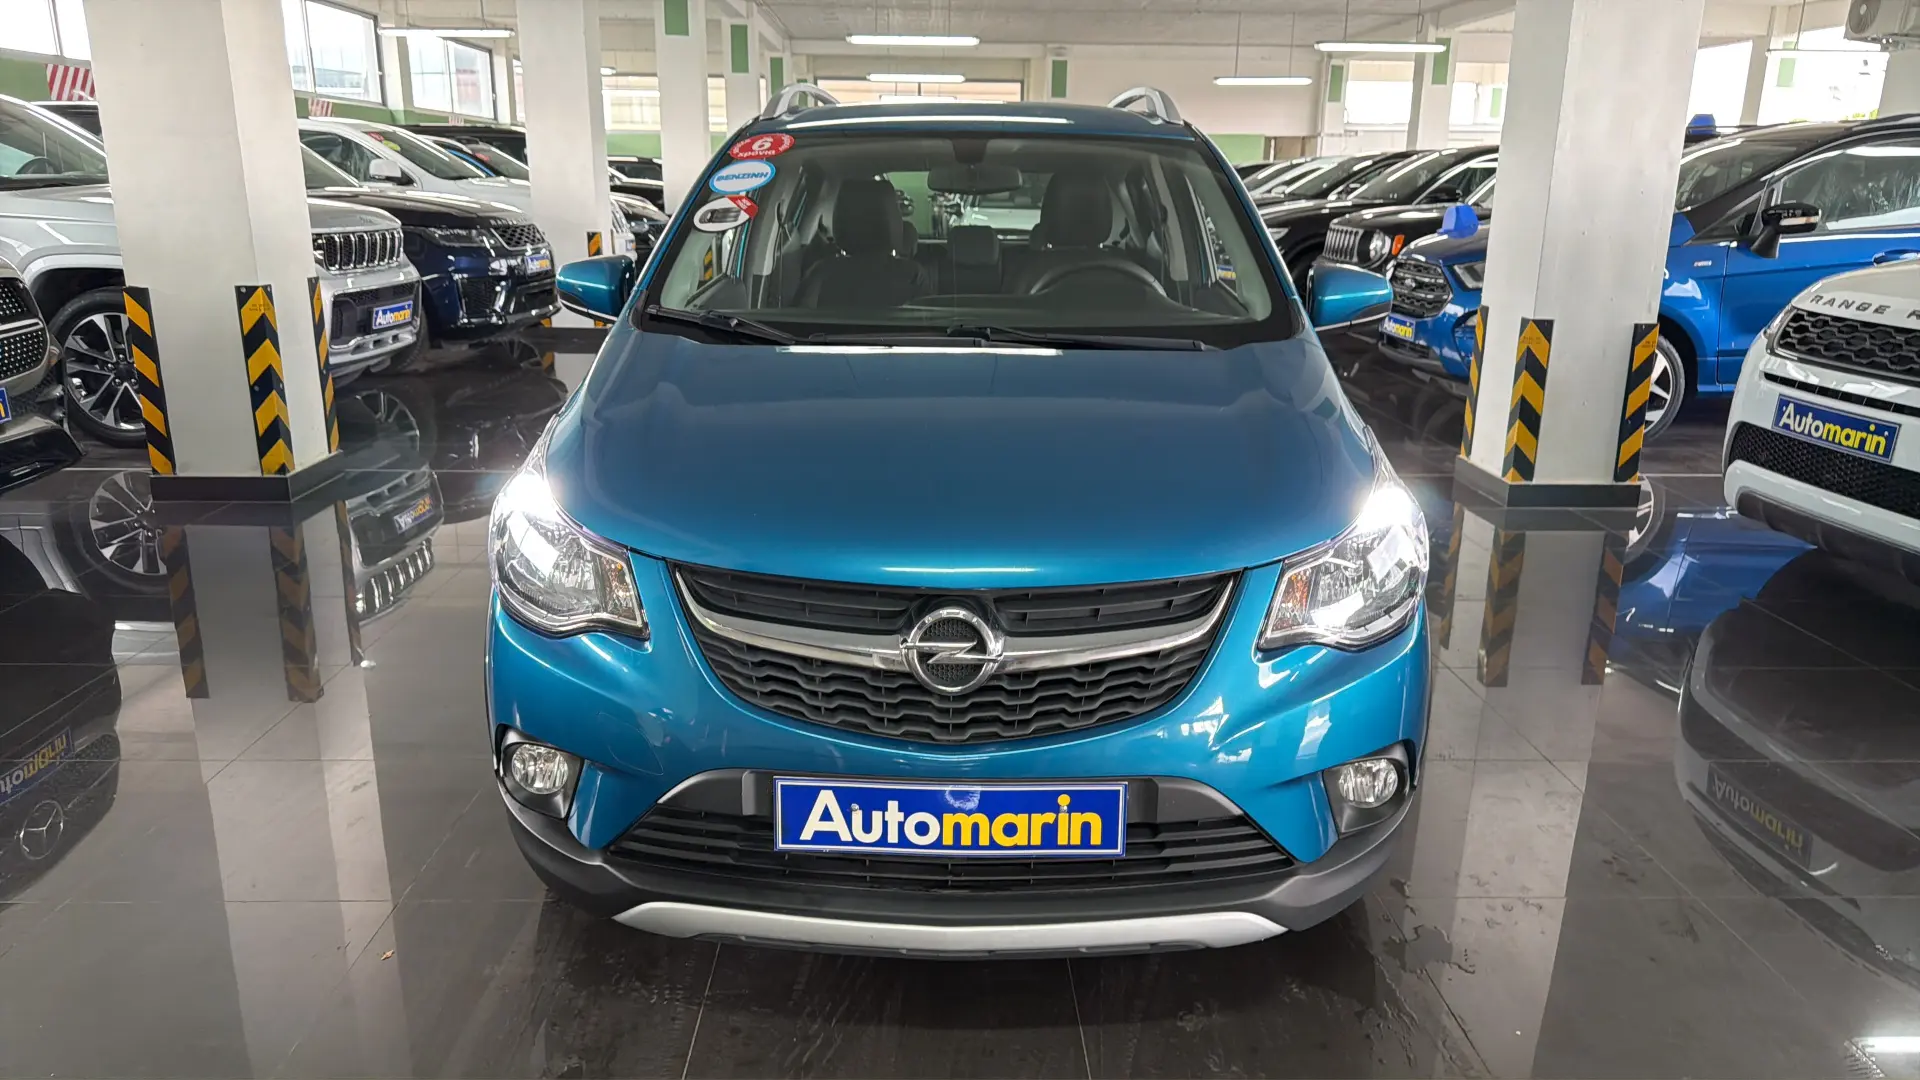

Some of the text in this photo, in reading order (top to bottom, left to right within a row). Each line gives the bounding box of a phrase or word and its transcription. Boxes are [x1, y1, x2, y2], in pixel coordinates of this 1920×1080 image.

[752, 136, 774, 151] 6
[1809, 294, 1891, 315] RANGE
[1779, 402, 1886, 456] Automarin
[799, 789, 1103, 848] Automarin
